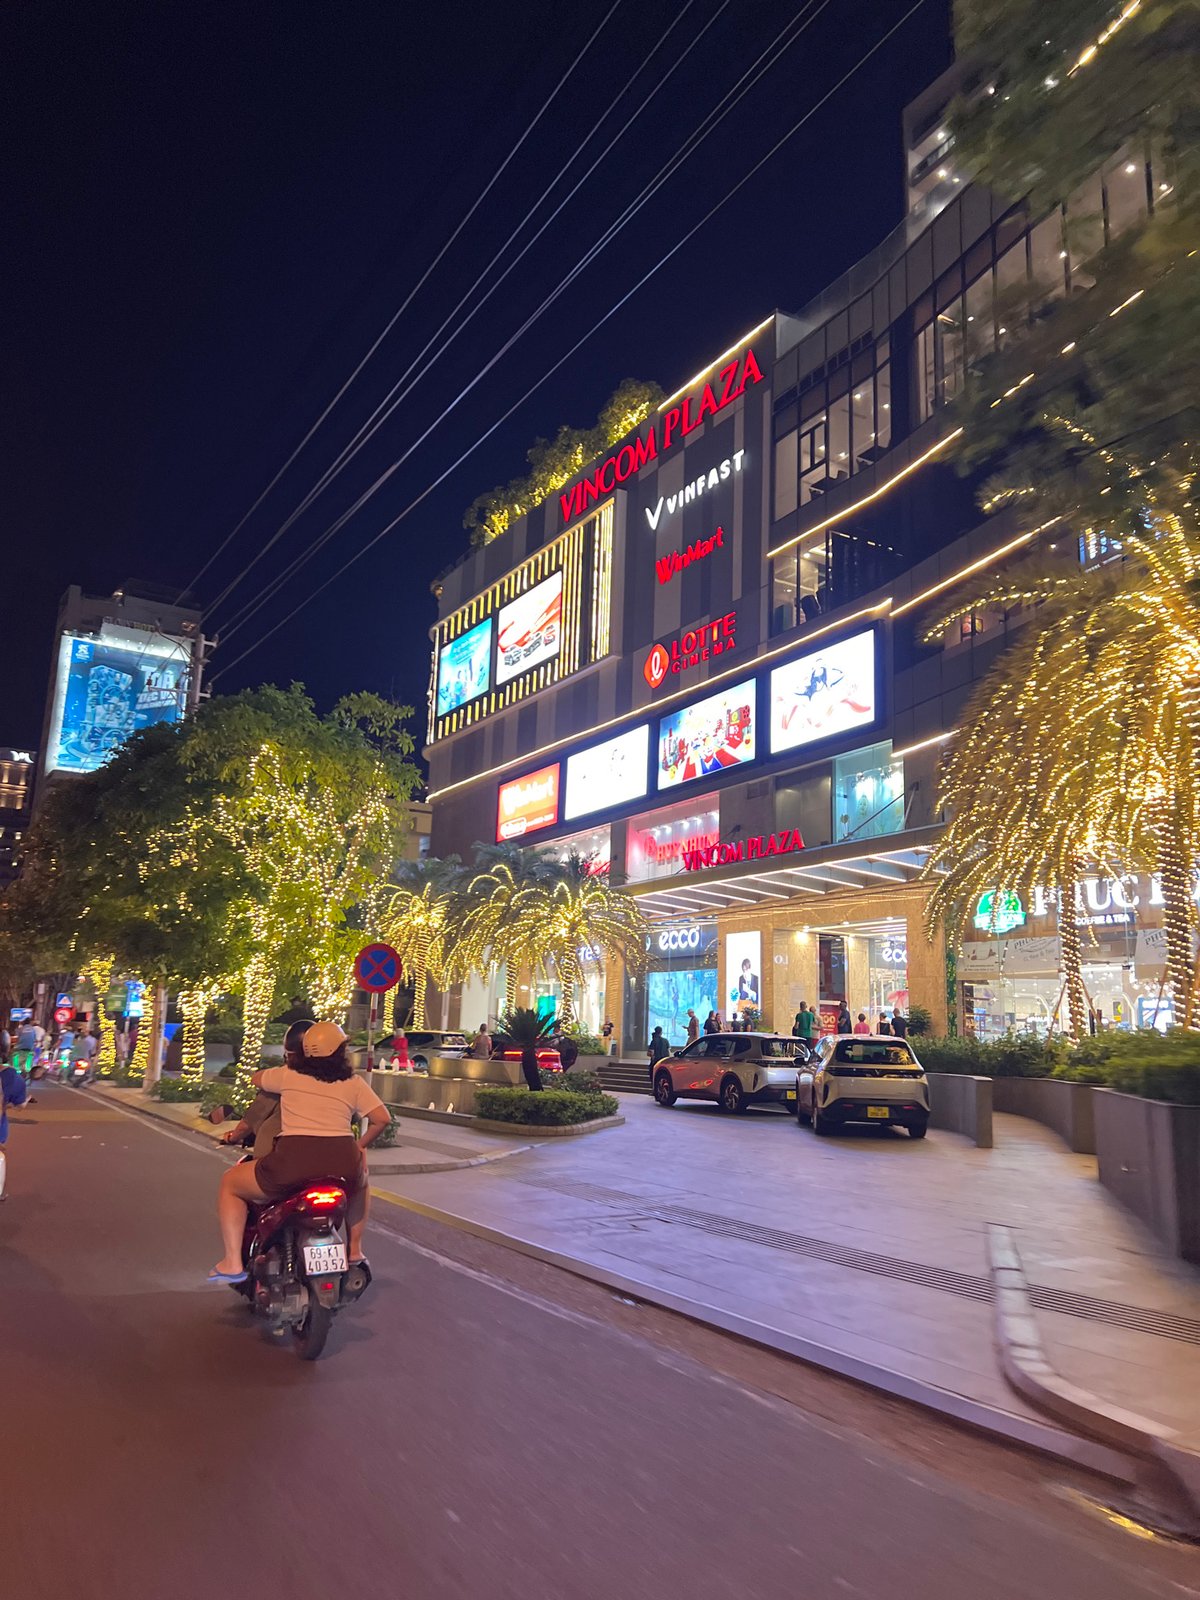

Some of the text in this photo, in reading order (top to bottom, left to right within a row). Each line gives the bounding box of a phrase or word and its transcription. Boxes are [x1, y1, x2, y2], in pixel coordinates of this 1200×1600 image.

[559, 349, 765, 523] VINCOM PLAZA
[666, 449, 745, 514] VINFAST
[655, 526, 724, 585] WinMart
[671, 611, 737, 661] LOTTE
[671, 636, 737, 674] CINEMA
[682, 827, 805, 871] VINCOM PLAZA
[659, 926, 700, 951] ecco
[308, 1258, 345, 1273] 403.52
